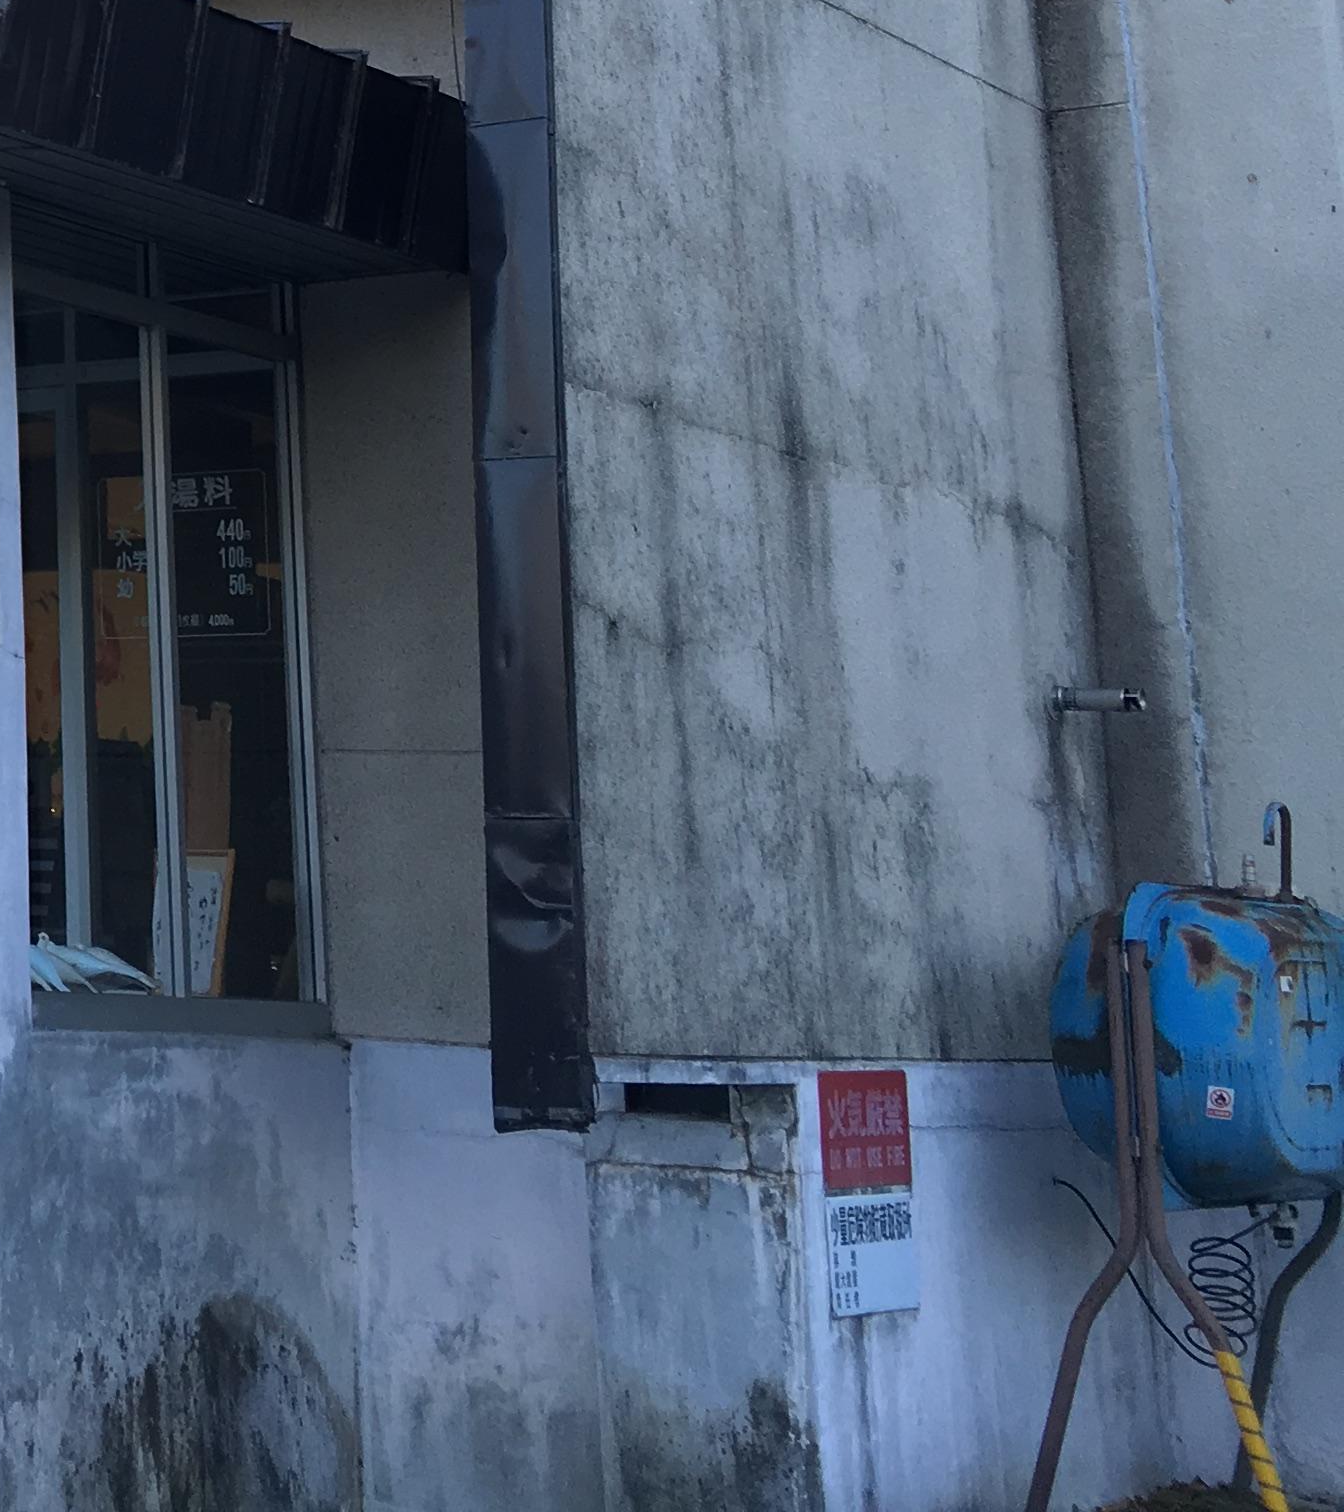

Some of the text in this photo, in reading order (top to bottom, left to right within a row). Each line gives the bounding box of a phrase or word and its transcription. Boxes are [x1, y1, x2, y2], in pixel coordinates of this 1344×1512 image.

[216, 518, 252, 542] 440円
[217, 547, 253, 570] 100円
[228, 574, 255, 597] 50円
[827, 1088, 904, 1139] 火気厳禁
